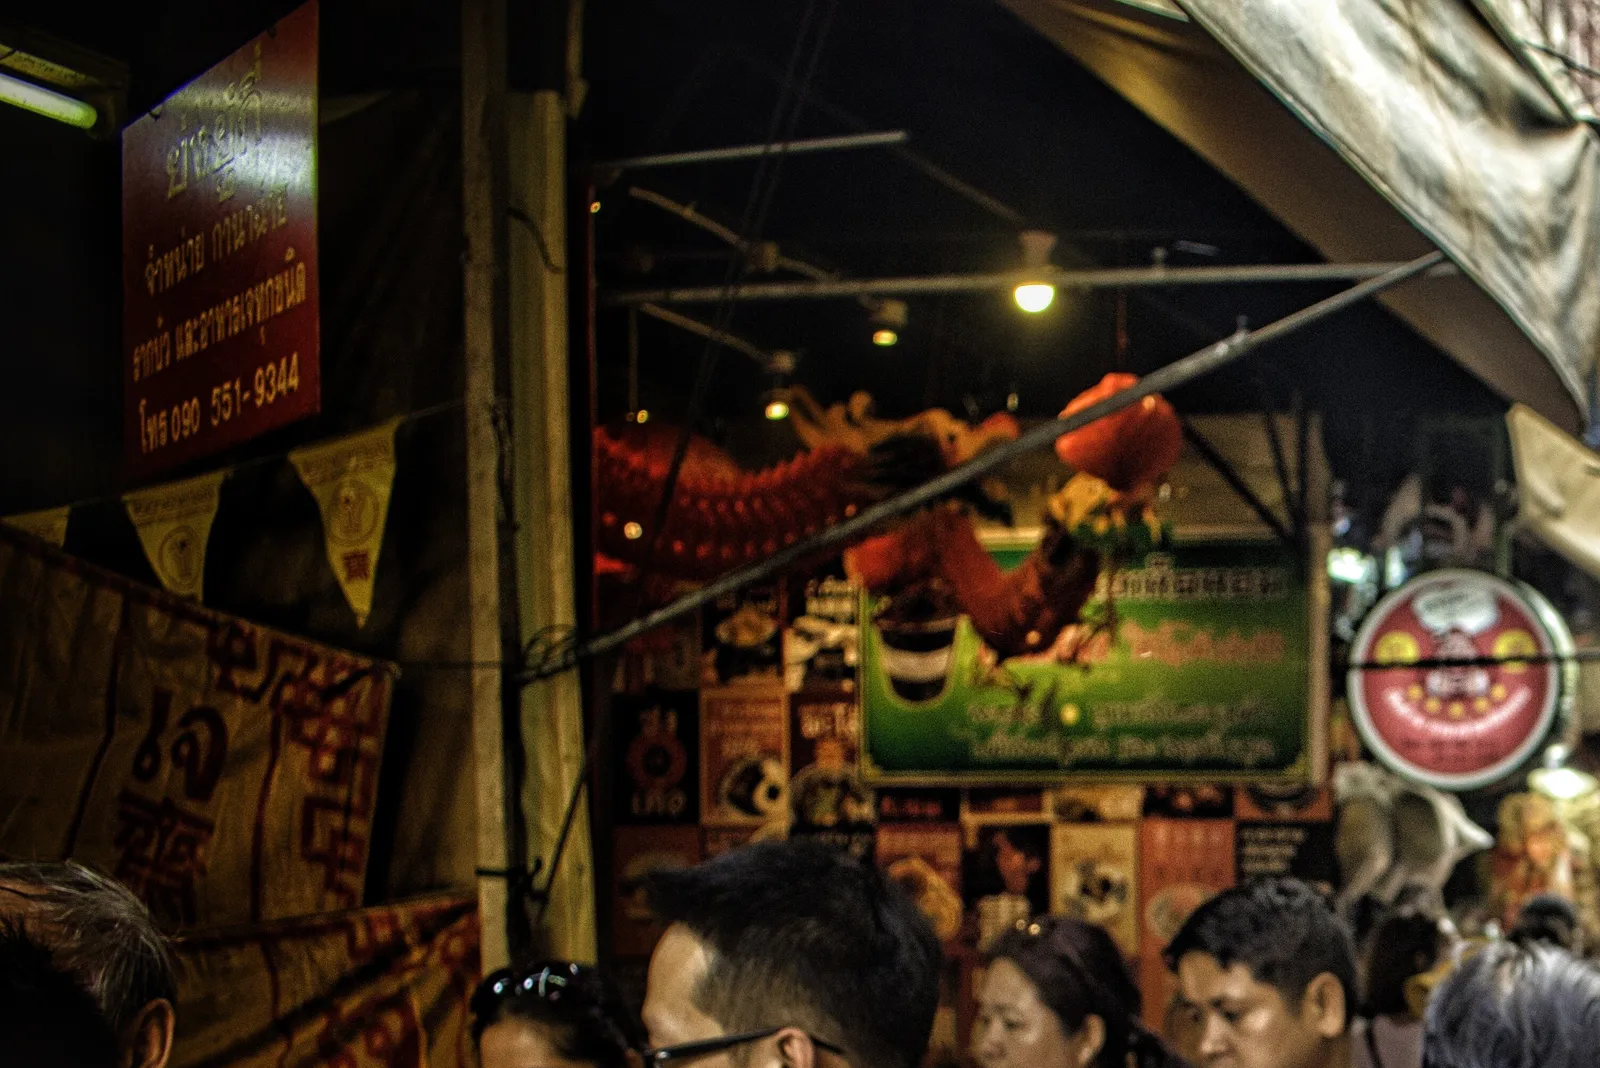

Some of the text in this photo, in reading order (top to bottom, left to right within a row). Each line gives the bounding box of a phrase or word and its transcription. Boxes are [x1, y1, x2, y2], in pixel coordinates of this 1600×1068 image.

[171, 396, 201, 442] 090
[211, 352, 299, 427] 551-9344
[133, 688, 228, 801] เจ
